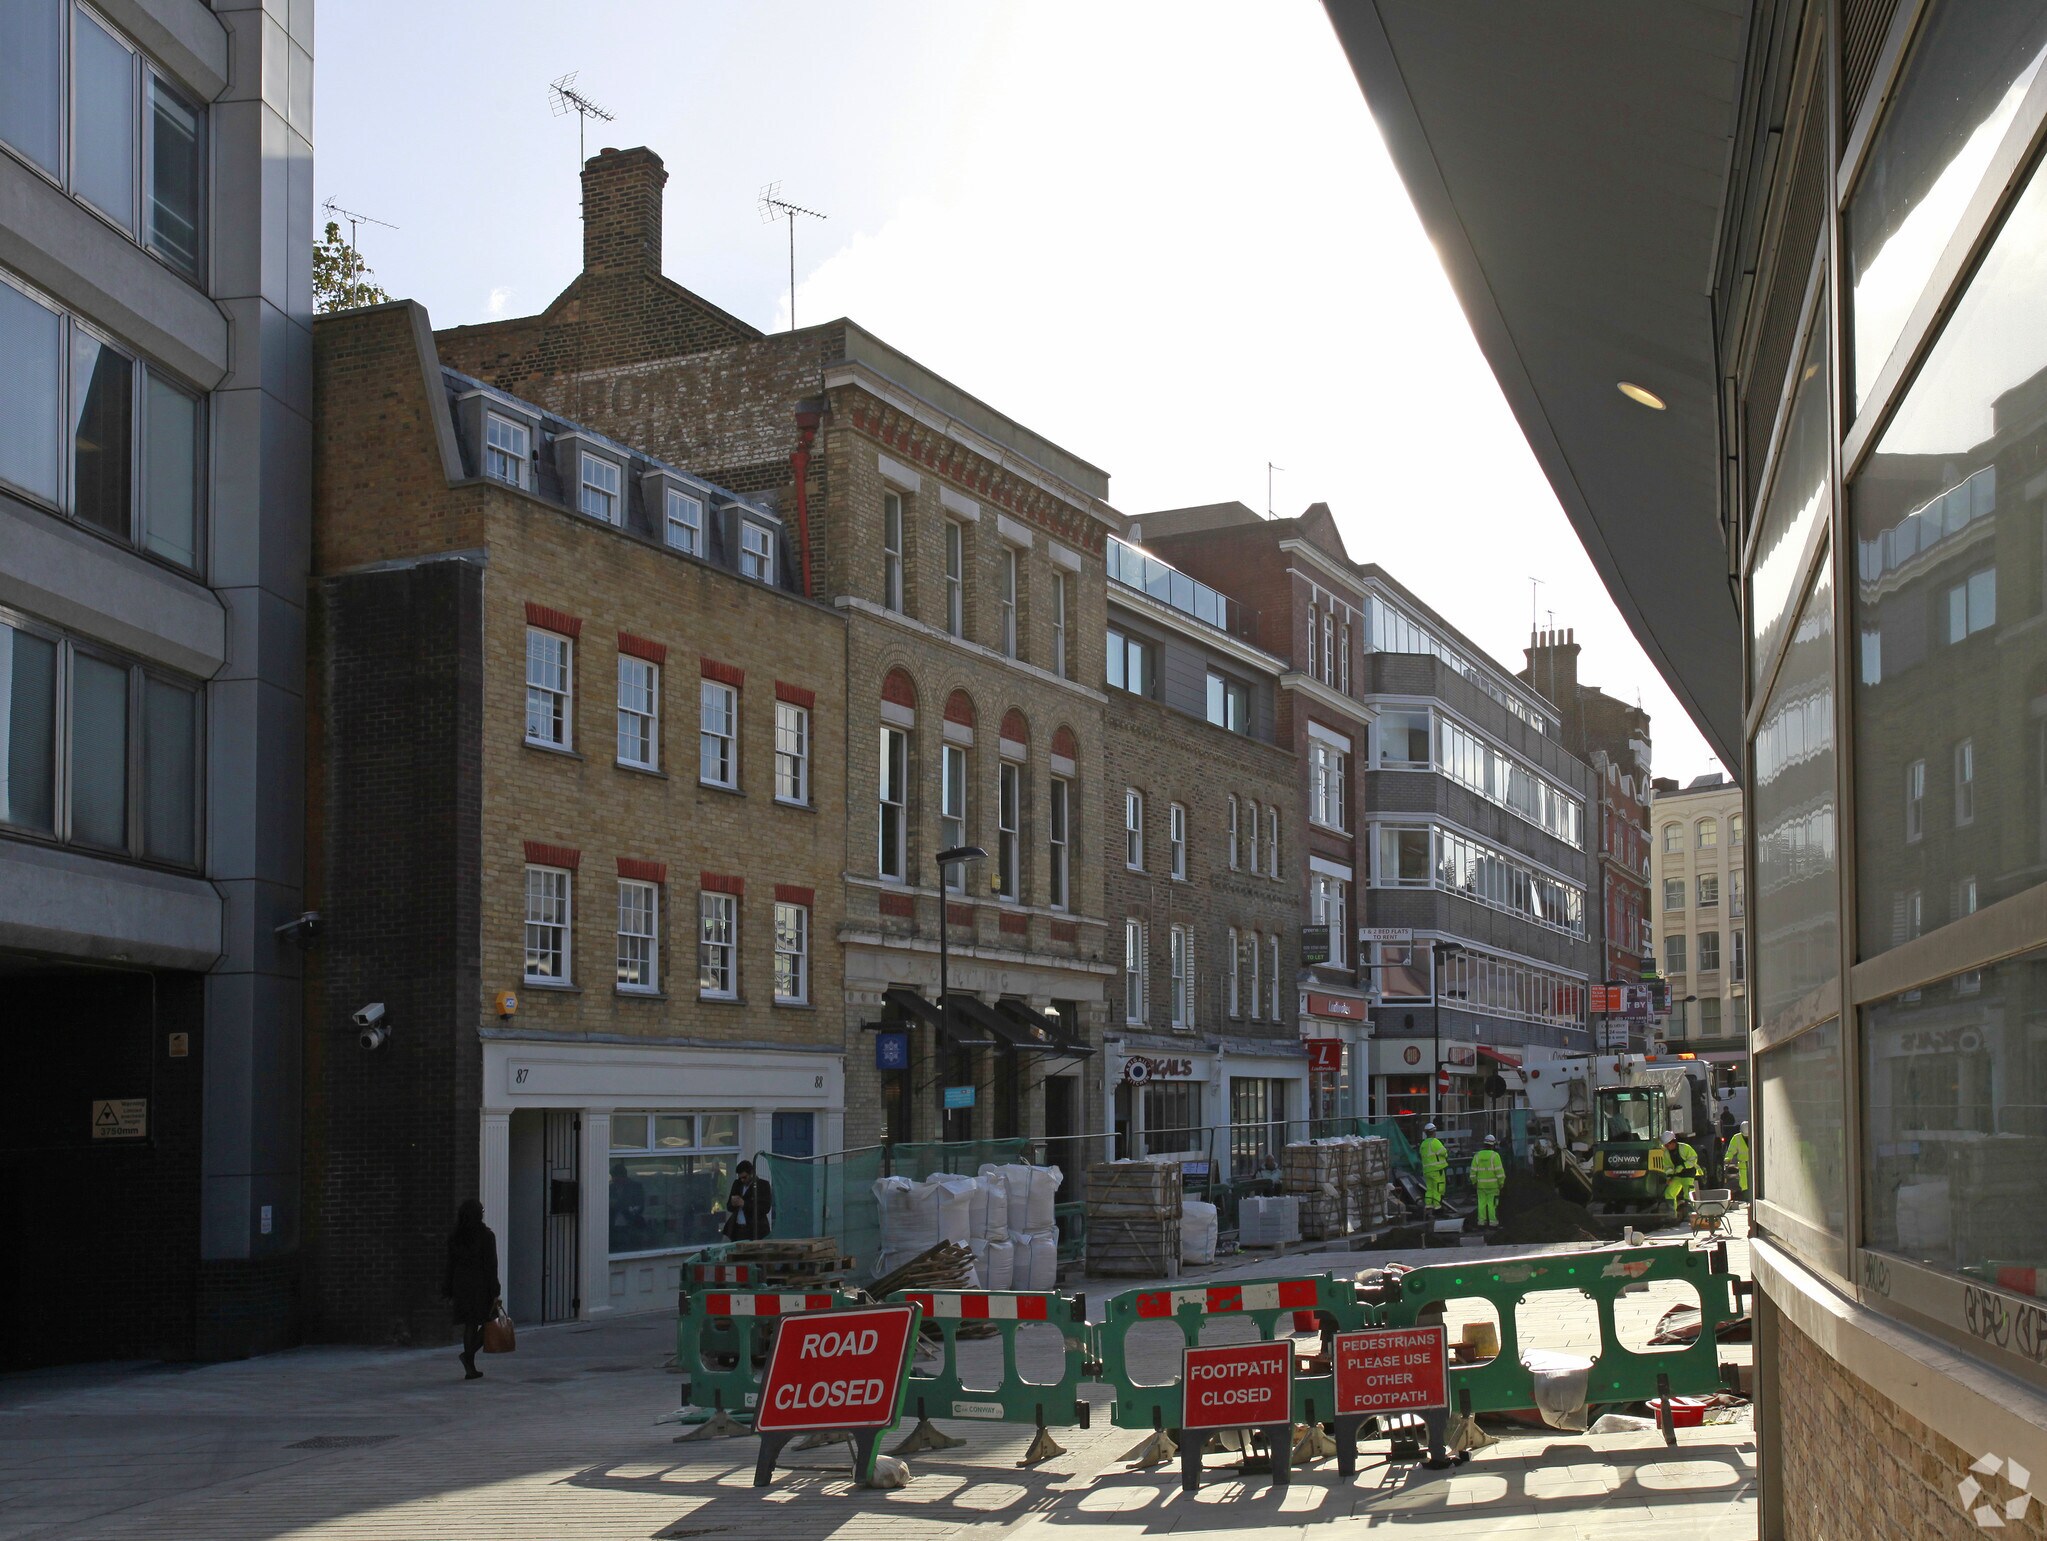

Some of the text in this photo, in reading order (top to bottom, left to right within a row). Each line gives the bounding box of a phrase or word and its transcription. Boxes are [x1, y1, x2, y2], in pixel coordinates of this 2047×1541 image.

[1318, 1046, 1329, 1064] L
[516, 1068, 529, 1084] 87
[814, 1075, 824, 1089] 88
[100, 1127, 139, 1136] 3750mm
[800, 1329, 878, 1359] ROAD
[1342, 1334, 1436, 1352] PEDESTRIANS
[1191, 1360, 1283, 1380] FOOTPATH
[1348, 1353, 1431, 1370] PLEASE USE
[1366, 1373, 1413, 1387] OTHER
[774, 1378, 885, 1410] CLOSED
[1201, 1387, 1272, 1406] CLOSED
[1354, 1390, 1427, 1406] FOOTPATH
